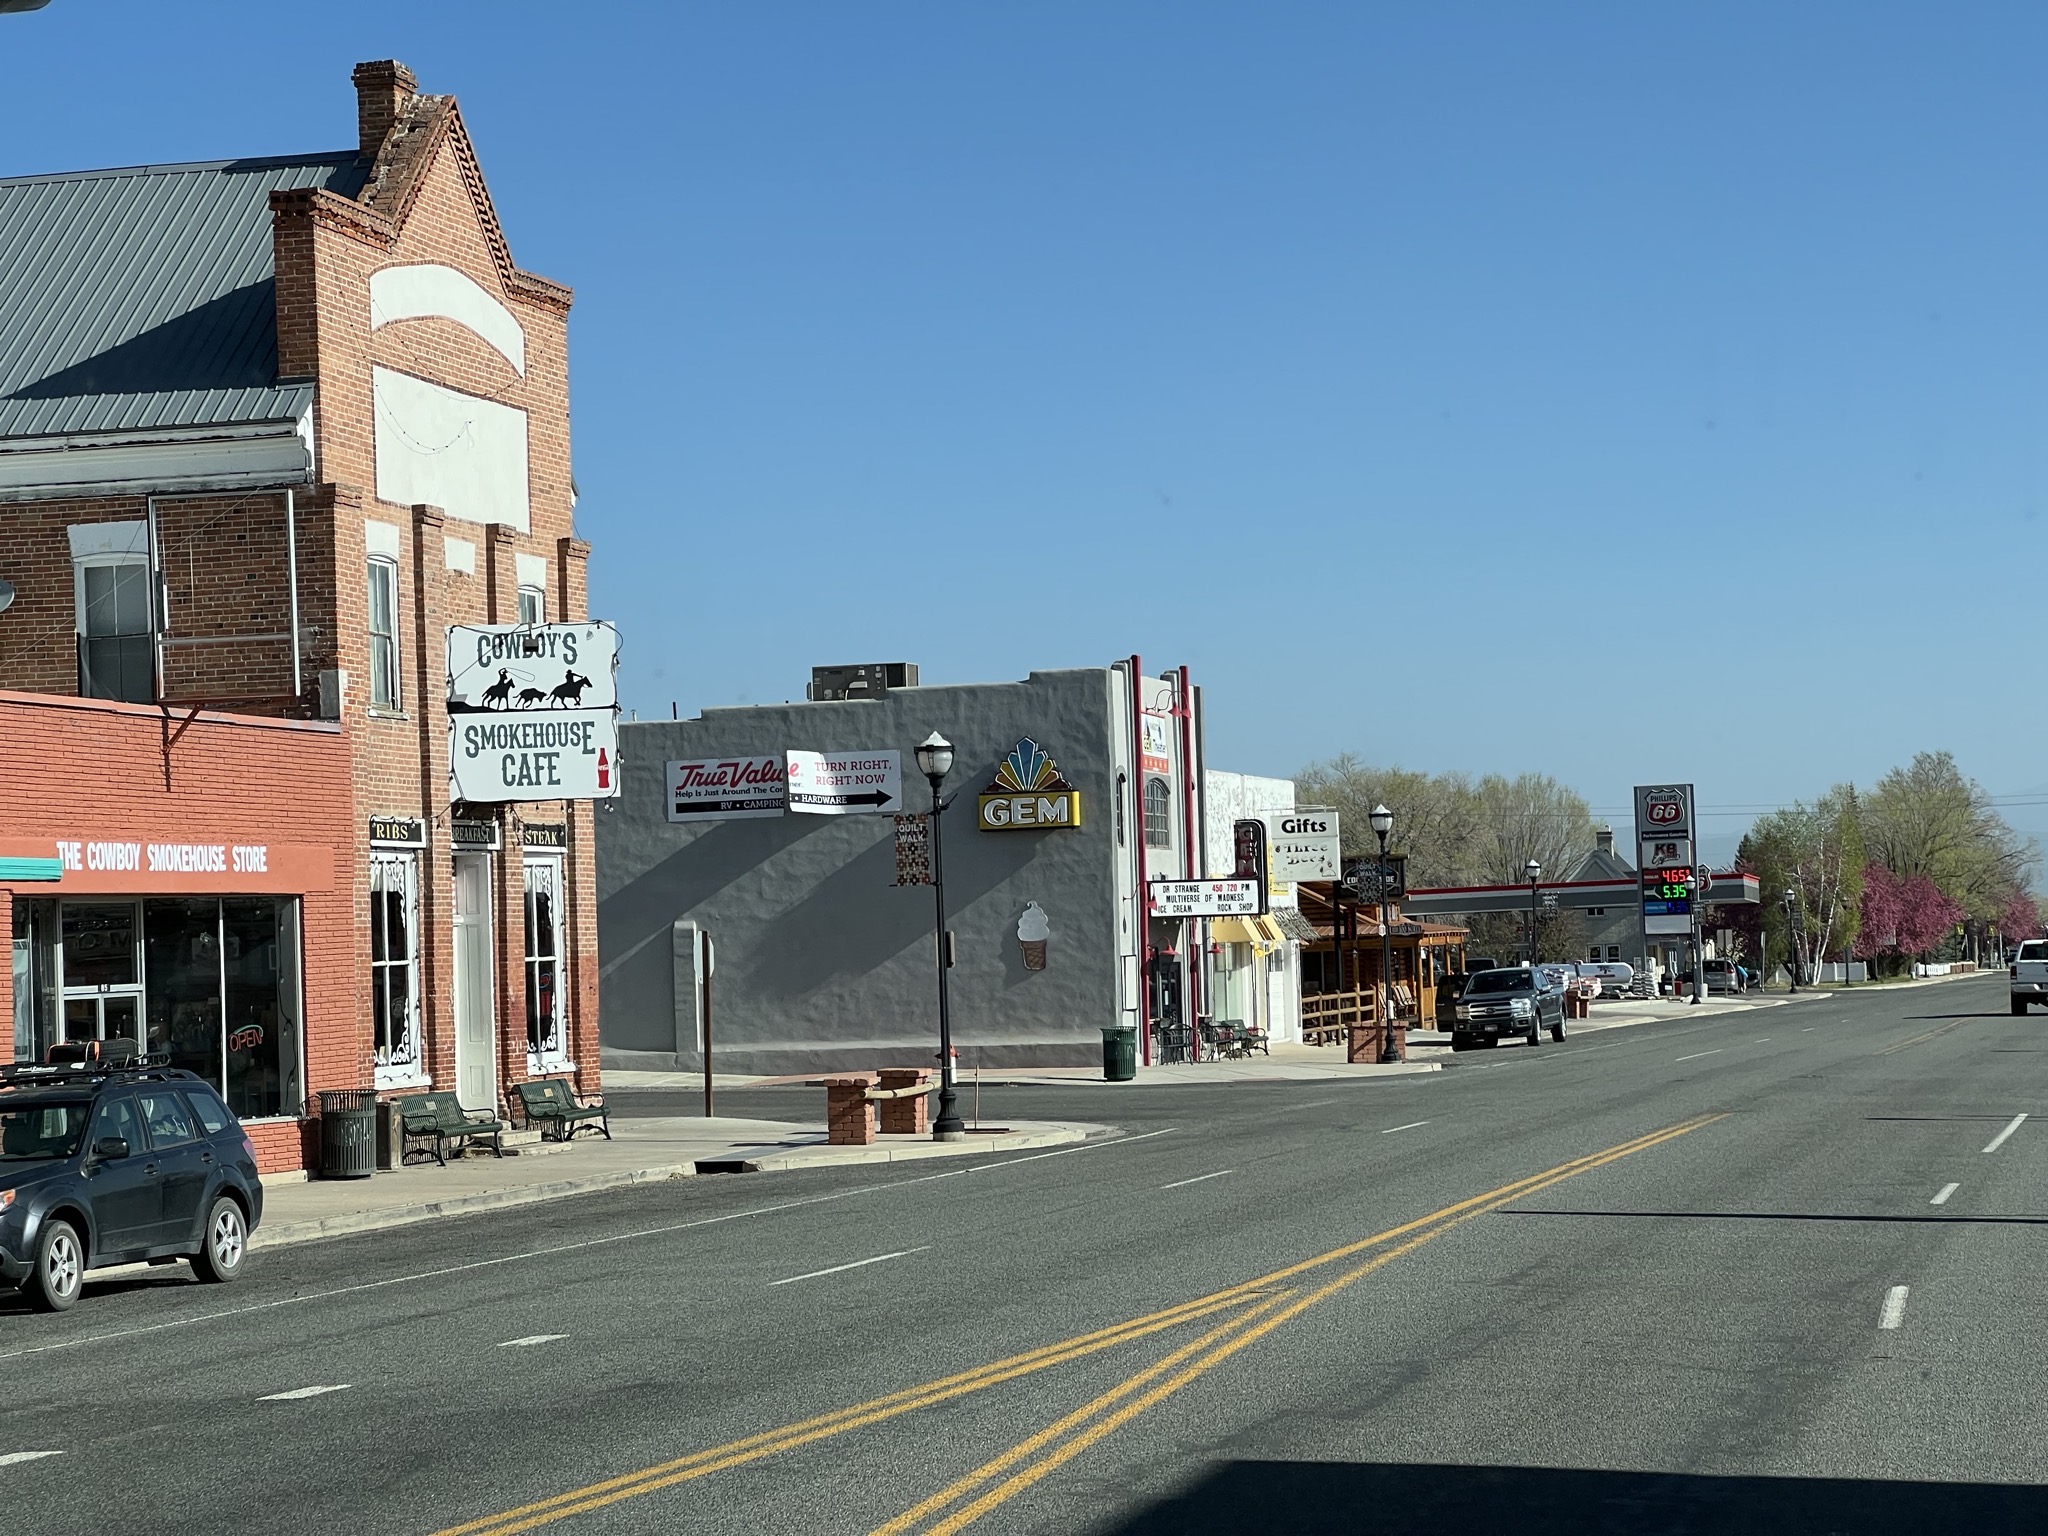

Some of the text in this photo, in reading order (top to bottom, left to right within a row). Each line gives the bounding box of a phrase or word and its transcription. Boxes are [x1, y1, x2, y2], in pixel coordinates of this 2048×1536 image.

[464, 721, 596, 758] SMOKEHOUSE
[502, 752, 561, 787] CAFE
[815, 759, 892, 772] TURN RIGHT,
[816, 773, 885, 786] RIGHT NOW
[675, 790, 693, 798] Help
[721, 787, 751, 795] Around
[753, 786, 767, 794] The
[1650, 794, 1677, 802] PHILLIPS
[721, 801, 732, 810] RV
[801, 794, 848, 805] HARDWARE
[984, 796, 1068, 826] GEM
[1652, 804, 1677, 820] 66
[376, 823, 409, 840] RIBS
[898, 823, 924, 833] QUILT
[1281, 818, 1327, 834] Gifts
[451, 826, 490, 843] BREAKFAST
[525, 830, 558, 845] STEAK
[899, 833, 925, 843] WALK
[56, 841, 268, 873] THE COWBOY SMOKEHOUSE STORE
[1162, 883, 1250, 893] DR STRANGE 450 720 PM
[1166, 893, 1245, 903] MULTIVERSE OF MADNESS
[1158, 902, 1254, 913] ICE CREAM ROCK SHOP
[230, 1029, 262, 1051] OPEN
